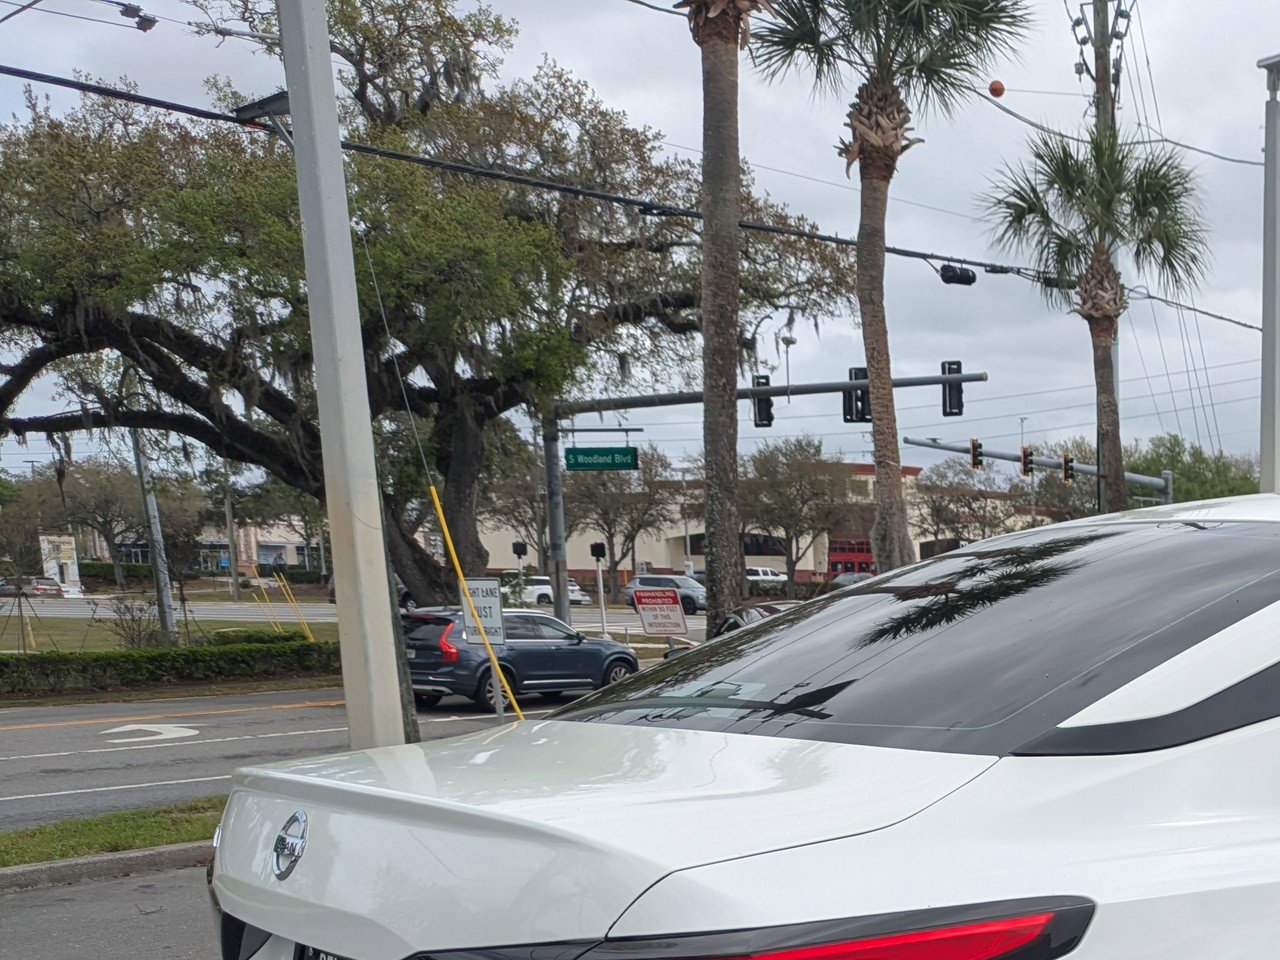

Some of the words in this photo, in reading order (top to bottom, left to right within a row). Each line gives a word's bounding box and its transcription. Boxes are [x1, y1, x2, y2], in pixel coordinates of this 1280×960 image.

[568, 454, 575, 464] S
[577, 454, 612, 464] Woodland
[614, 454, 632, 464] Blvd
[481, 587, 499, 598] LANE
